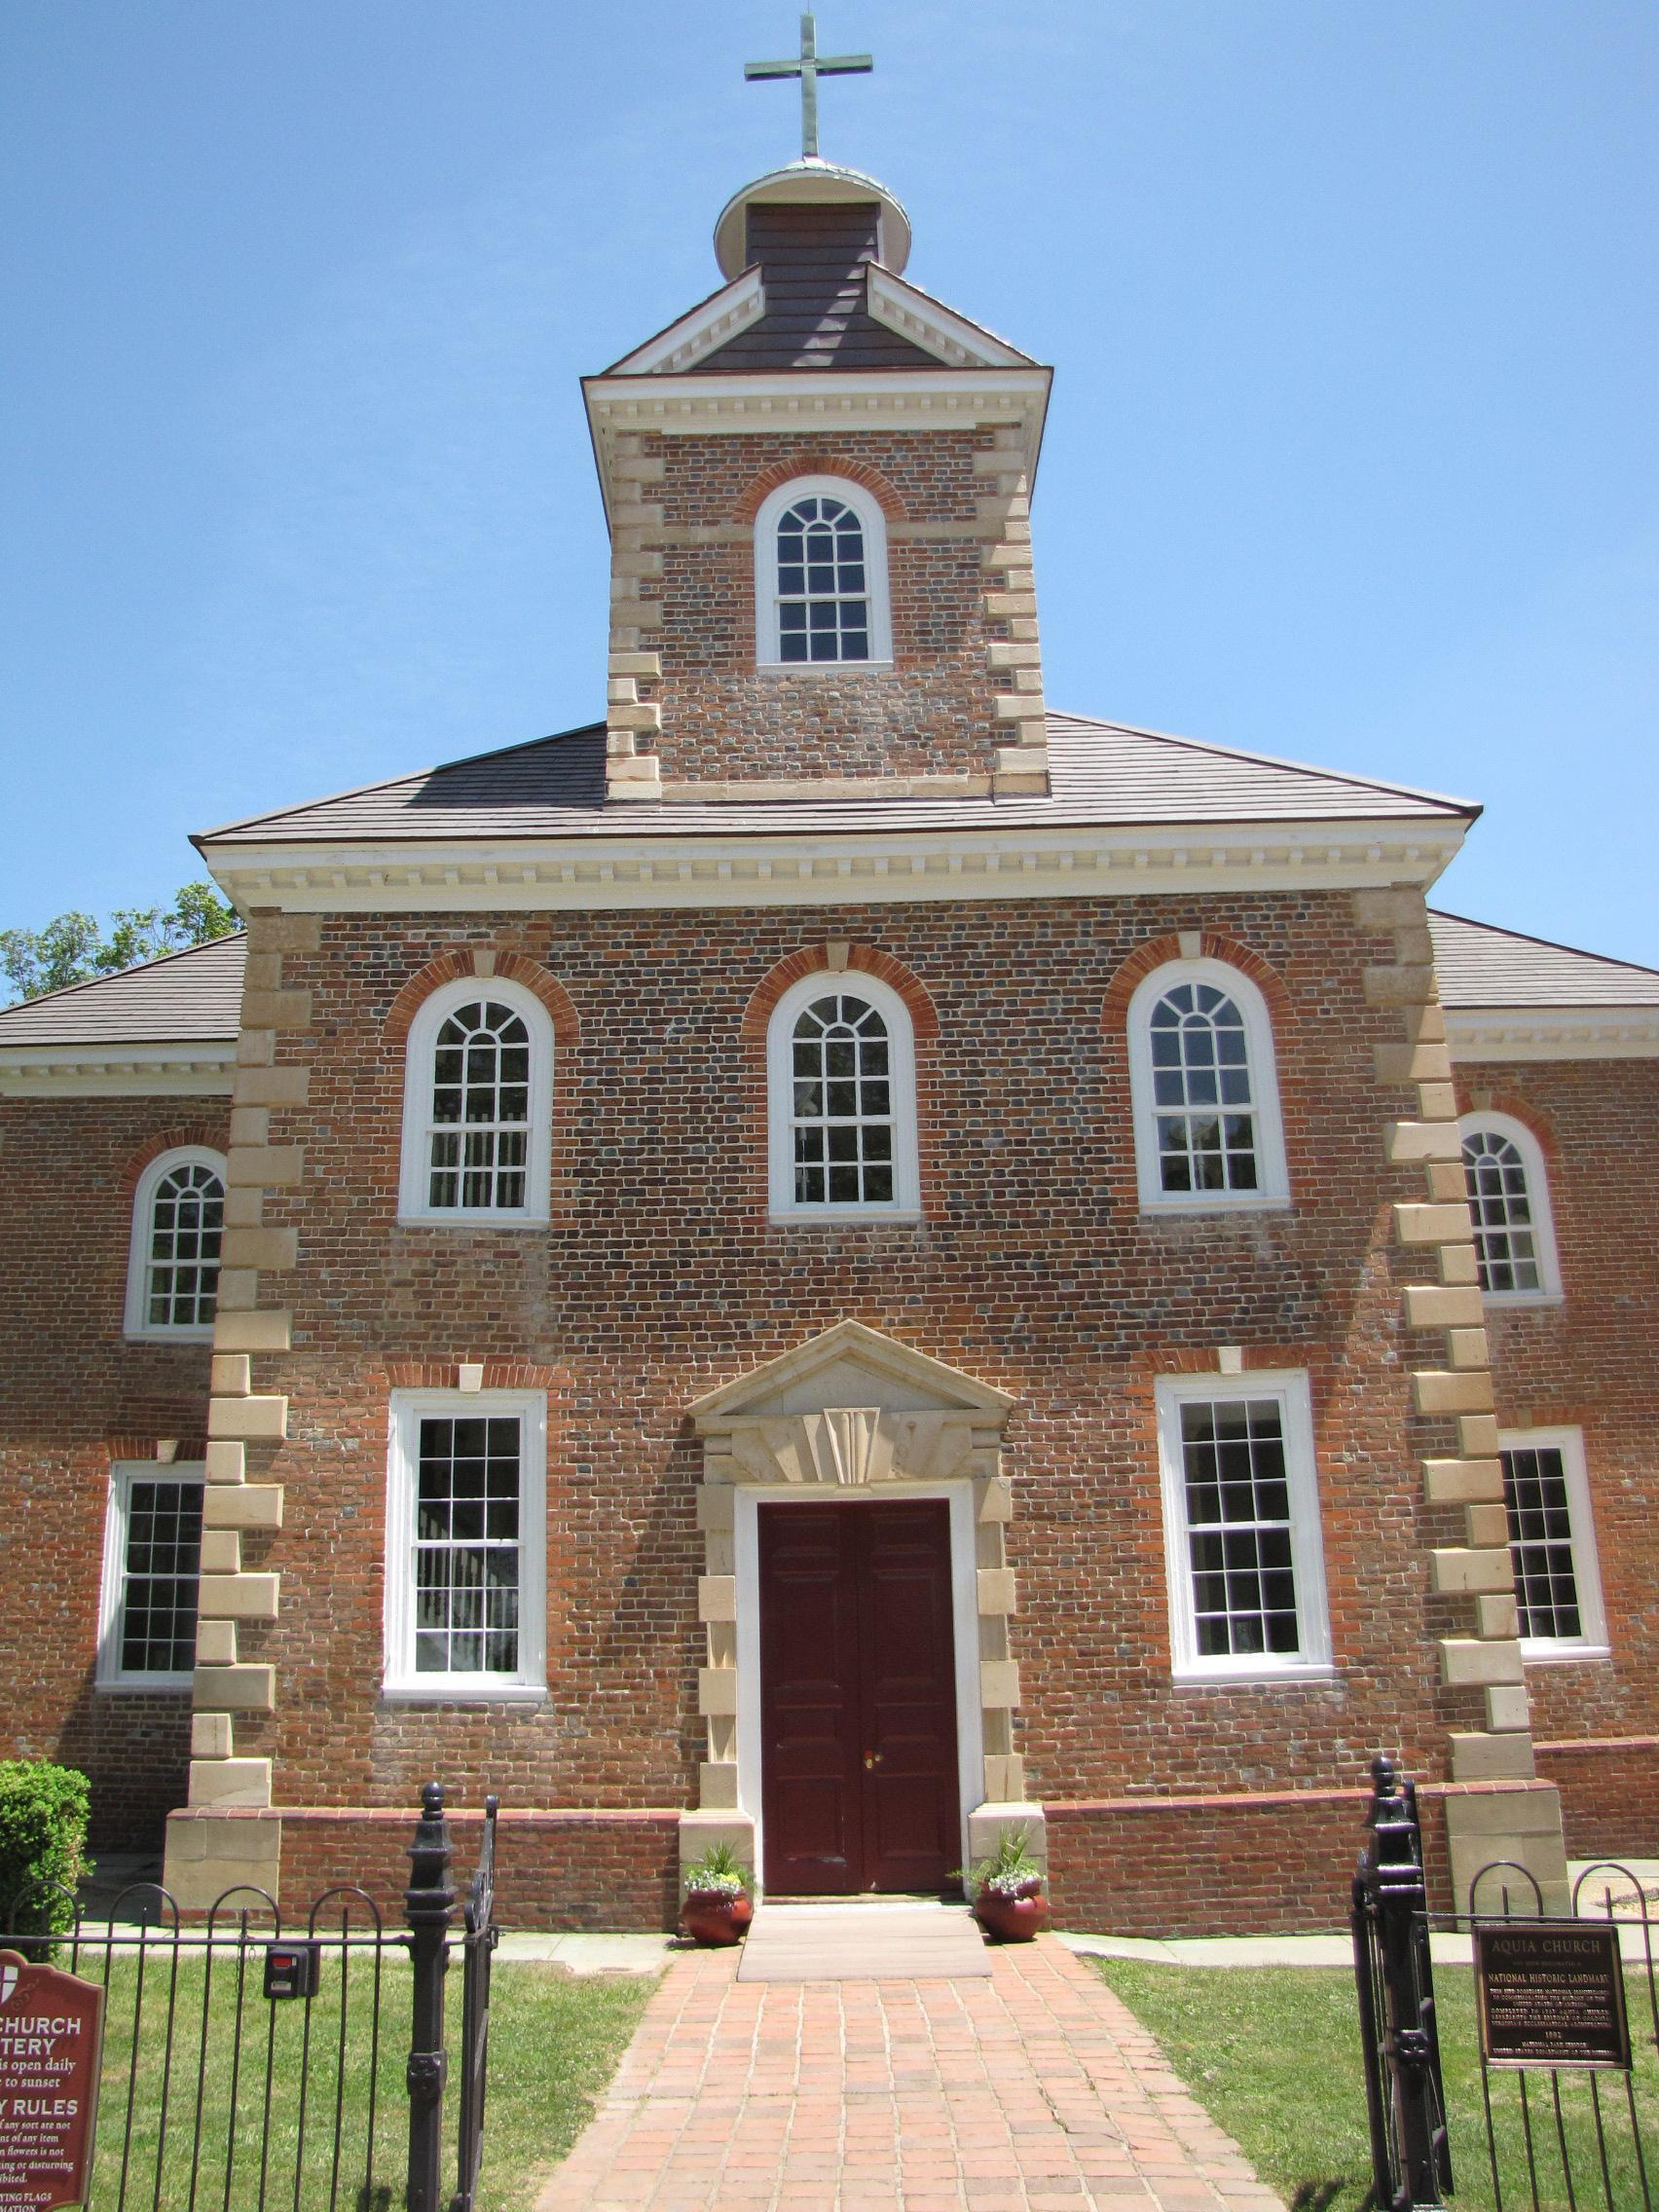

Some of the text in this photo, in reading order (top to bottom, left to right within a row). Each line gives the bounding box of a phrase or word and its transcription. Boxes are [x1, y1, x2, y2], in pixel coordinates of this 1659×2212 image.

[1492, 1938, 1602, 1955] AQUIA CHURCH
[1488, 1972, 1527, 1983] NATIONAL
[1530, 1973, 1566, 1983] HISTORIC
[11, 2060, 42, 2075] open
[45, 2056, 77, 2076] daily
[5, 2077, 18, 2088] to
[20, 2078, 61, 2088] sunset
[13, 2099, 79, 2116] RULES
[4, 2121, 20, 2132] any
[11, 2132, 23, 2142] of
[22, 2134, 38, 2145] any
[39, 2132, 59, 2143] item
[8, 2145, 39, 2156] flowers
[40, 2146, 48, 2156] is
[28, 2159, 74, 2173] disturbing
[23, 2193, 53, 2202] FLAGS
